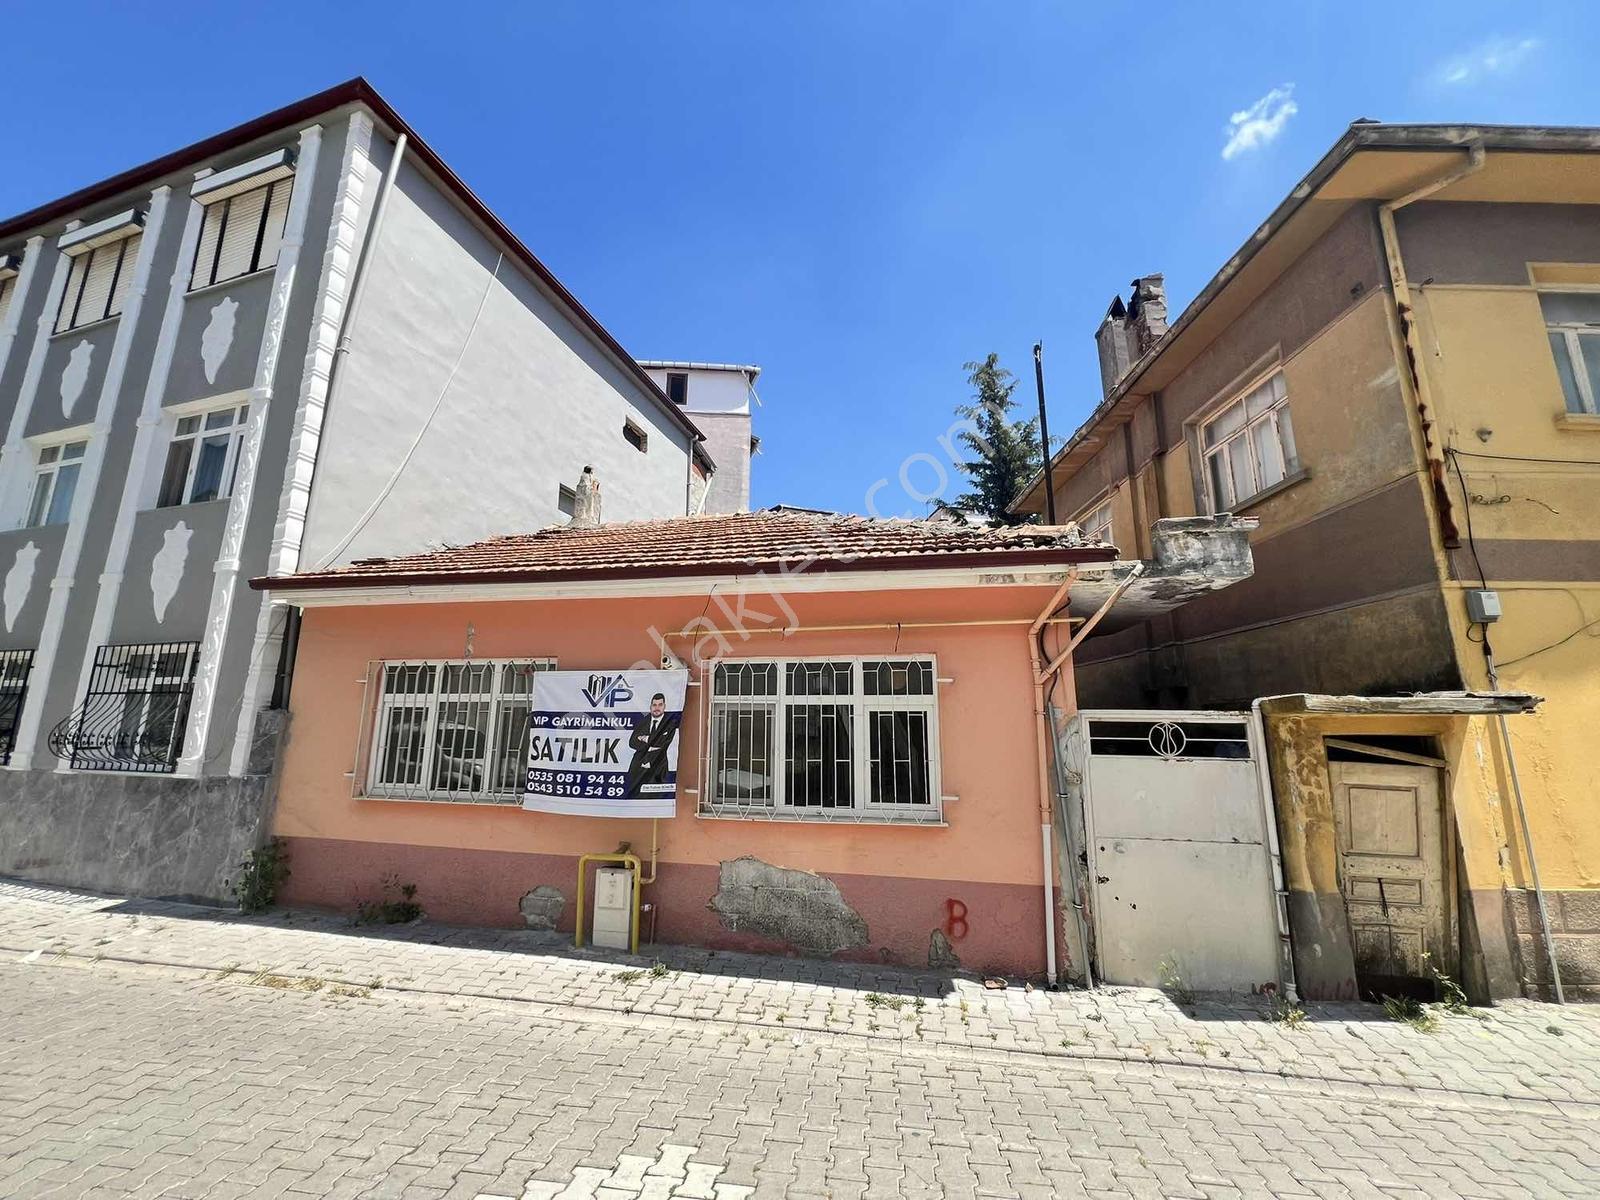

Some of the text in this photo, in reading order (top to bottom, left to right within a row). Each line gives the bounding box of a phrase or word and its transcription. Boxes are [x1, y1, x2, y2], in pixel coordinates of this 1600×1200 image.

[551, 714, 634, 727] GAYRİMENKUL
[530, 735, 621, 764] SATILIK
[528, 770, 625, 785] 0535 081 94 44
[526, 781, 625, 797] 0543 510 54 89
